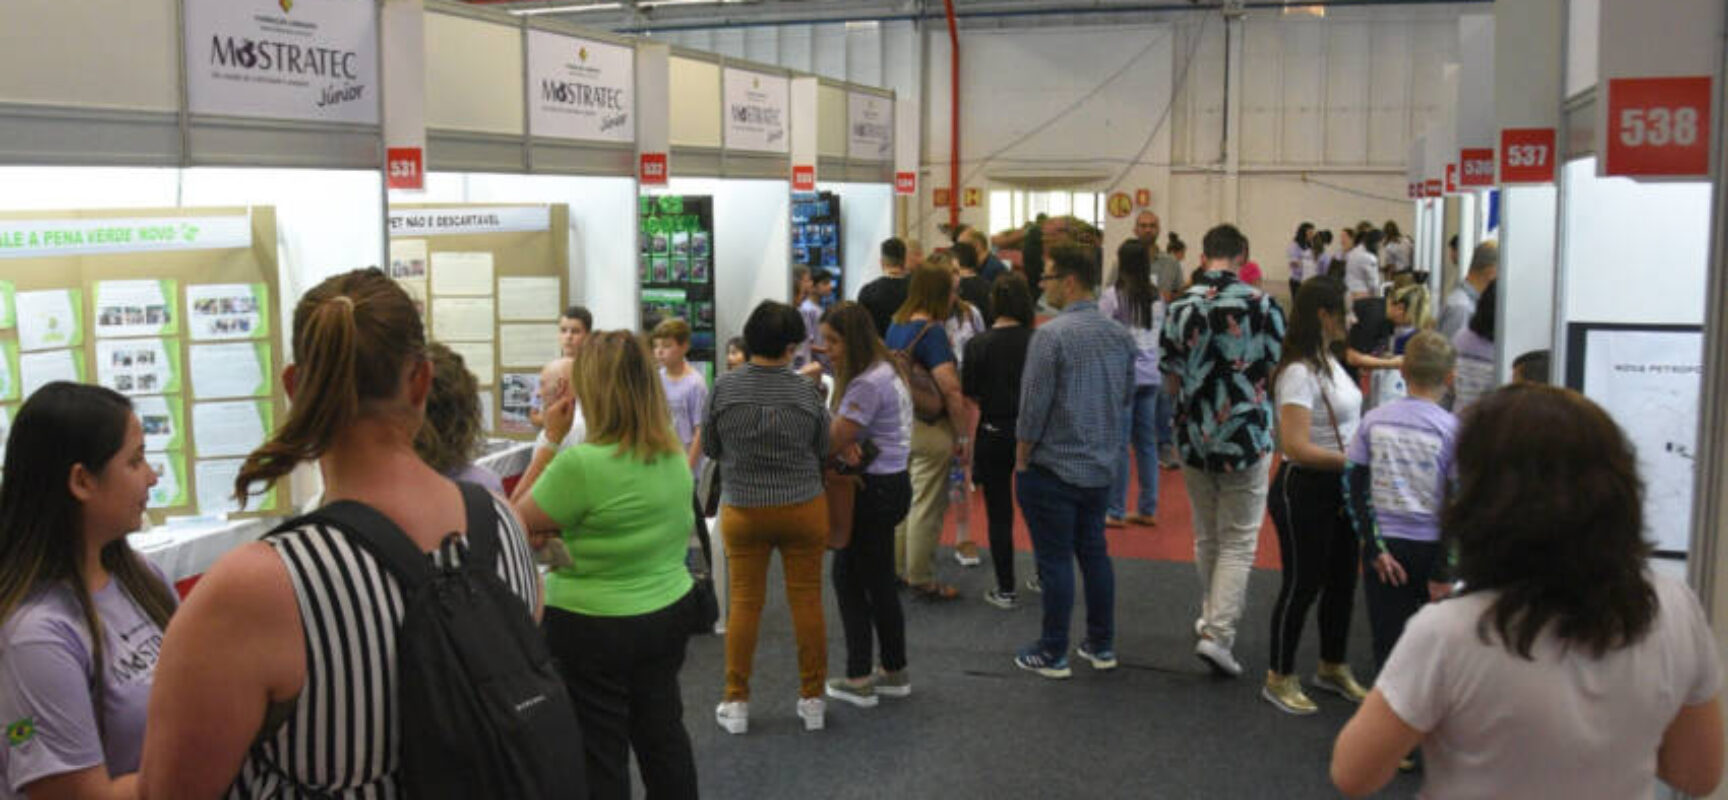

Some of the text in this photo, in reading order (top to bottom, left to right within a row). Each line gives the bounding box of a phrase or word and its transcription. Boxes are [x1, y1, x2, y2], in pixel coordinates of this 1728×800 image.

[210, 34, 357, 80] MOSTRATEC
[541, 79, 623, 111] MOSTRATEC
[1619, 107, 1698, 147] 538
[390, 160, 416, 178] 531
[1508, 145, 1547, 167] 537
[28, 230, 41, 246] A
[43, 230, 84, 246] PENA
[87, 226, 133, 244] VERDE
